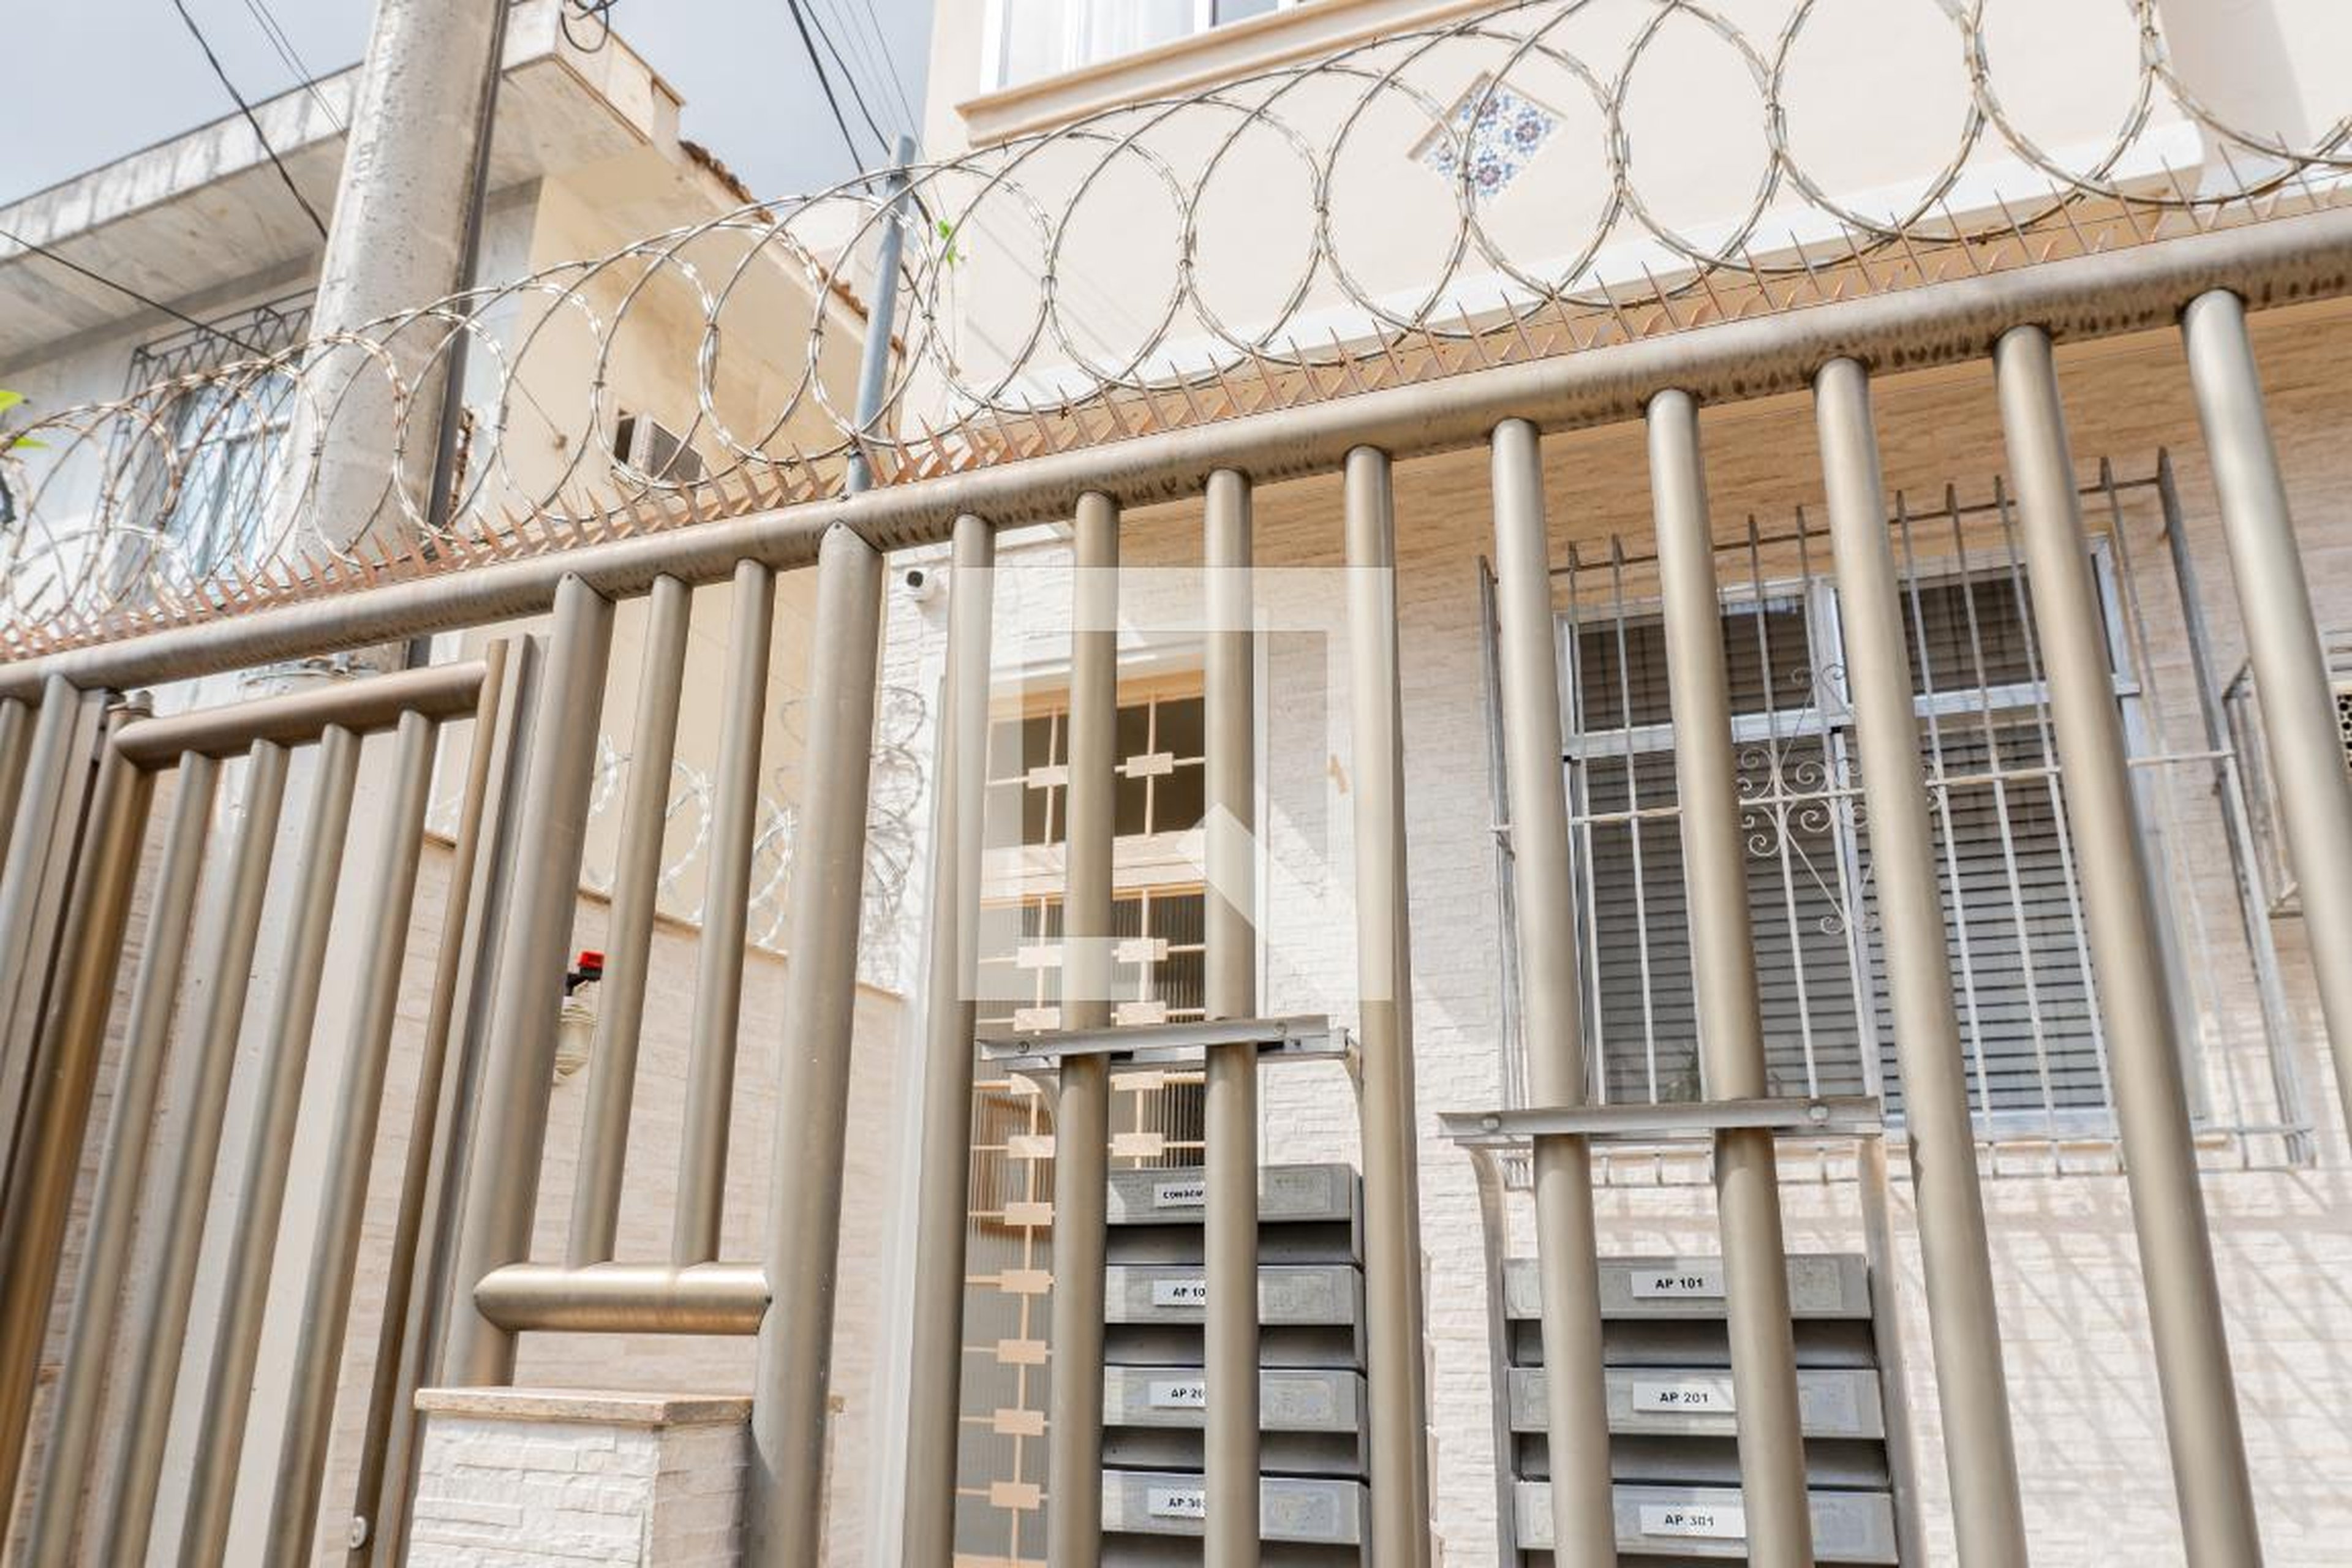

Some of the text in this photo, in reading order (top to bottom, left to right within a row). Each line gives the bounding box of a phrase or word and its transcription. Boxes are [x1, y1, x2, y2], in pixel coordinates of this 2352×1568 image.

[1656, 1277, 1703, 1289] AP 101
[1173, 1287, 1205, 1297] AP 10
[1171, 1388, 1204, 1398] AP 20
[1660, 1392, 1708, 1403] AP 201
[1169, 1498, 1185, 1507] AP
[1665, 1514, 1714, 1526] AP 301
